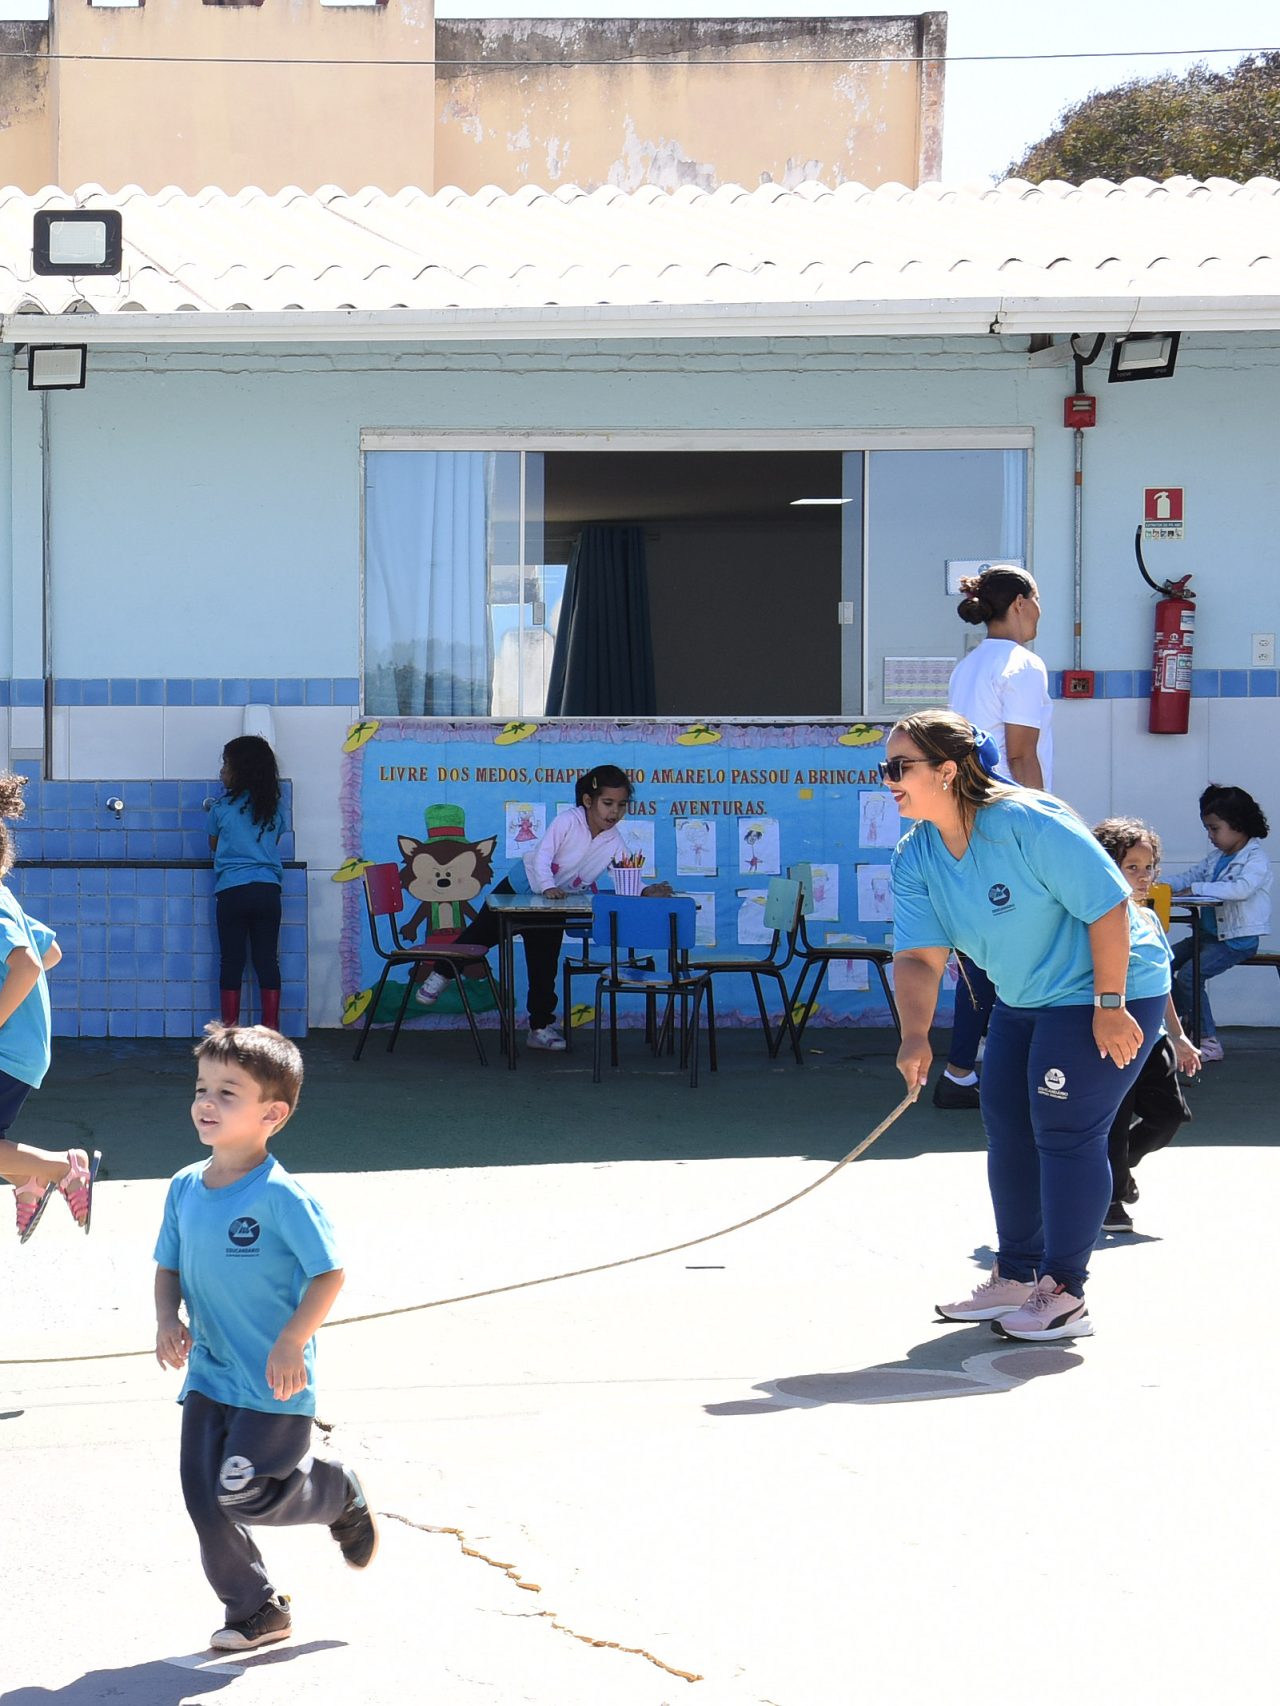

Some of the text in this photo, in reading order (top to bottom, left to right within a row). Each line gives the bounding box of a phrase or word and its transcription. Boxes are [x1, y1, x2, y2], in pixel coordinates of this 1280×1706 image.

[379, 766, 428, 782] LIVRE
[437, 766, 470, 782] DOS
[475, 767, 532, 785] MEDOS,
[650, 768, 726, 784] AMARELO
[731, 768, 790, 785] PASSOU
[794, 769, 804, 785] A
[669, 800, 768, 816] AVENTURAS.
